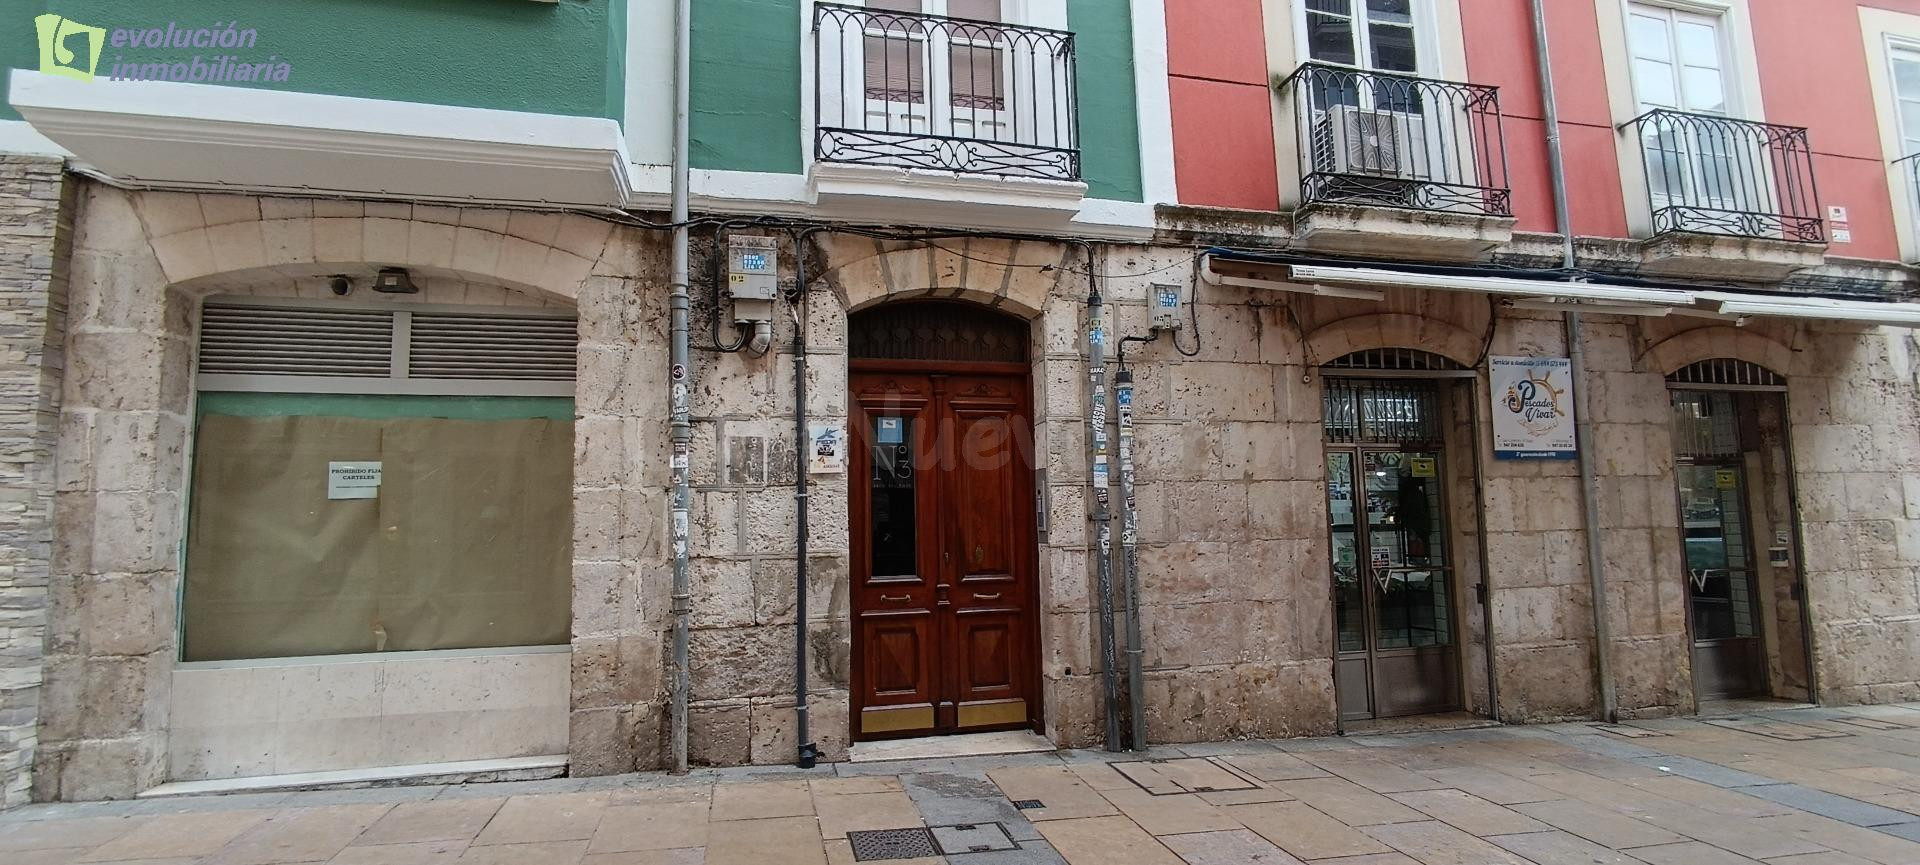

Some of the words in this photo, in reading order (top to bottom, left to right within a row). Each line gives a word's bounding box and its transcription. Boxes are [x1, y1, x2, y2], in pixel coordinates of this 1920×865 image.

[1508, 380, 1554, 413] Pescados
[1525, 407, 1556, 422] Vivar
[897, 460, 912, 479] 3
